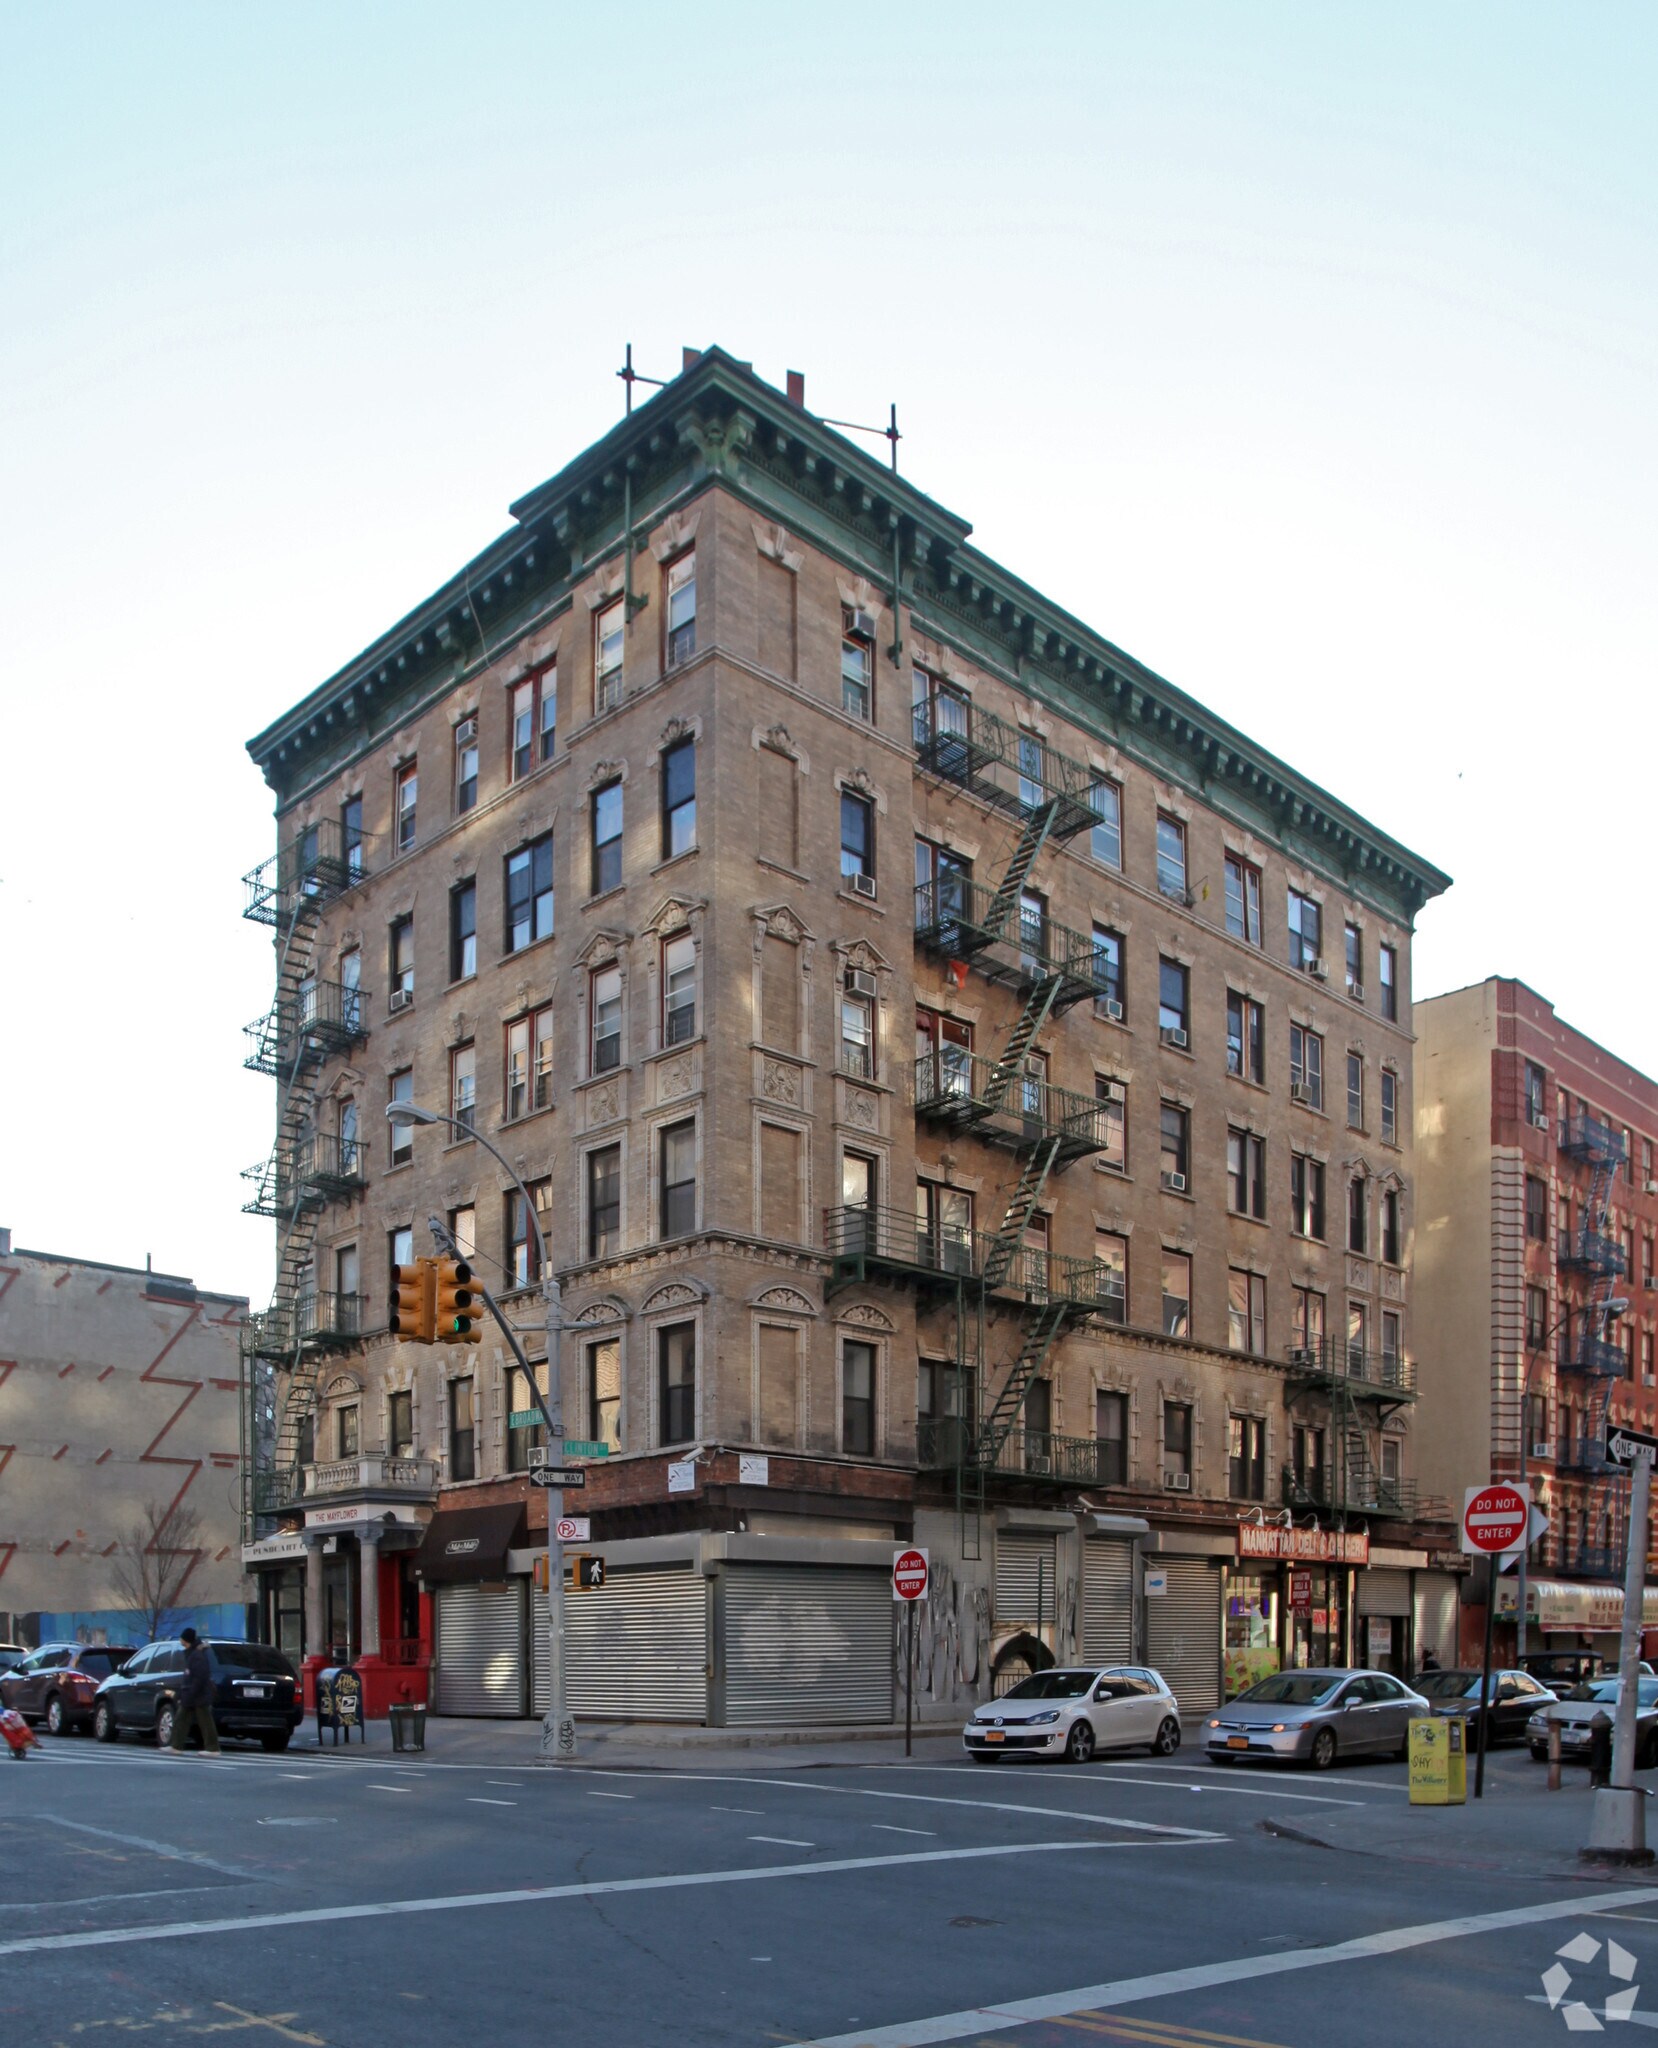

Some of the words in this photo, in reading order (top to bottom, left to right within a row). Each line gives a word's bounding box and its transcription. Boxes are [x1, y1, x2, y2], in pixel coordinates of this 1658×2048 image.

[515, 1411, 544, 1425] BROADWA
[564, 1442, 599, 1455] CLINTON
[1616, 1439, 1632, 1457] ONE
[537, 1473, 554, 1482] ONE
[564, 1474, 581, 1483] WAY
[1476, 1499, 1492, 1511] DO
[1495, 1497, 1517, 1510] NOT
[315, 1513, 325, 1522] THE
[326, 1508, 358, 1521] MAYFLOWER
[1477, 1527, 1512, 1539] ENTER
[1242, 1529, 1295, 1553] MANHATTAN
[1298, 1533, 1316, 1555] DELI
[252, 1543, 298, 1555] PUSHCART
[900, 1561, 908, 1569] DO
[910, 1560, 921, 1568] NOT
[901, 1582, 920, 1590] ENTER
